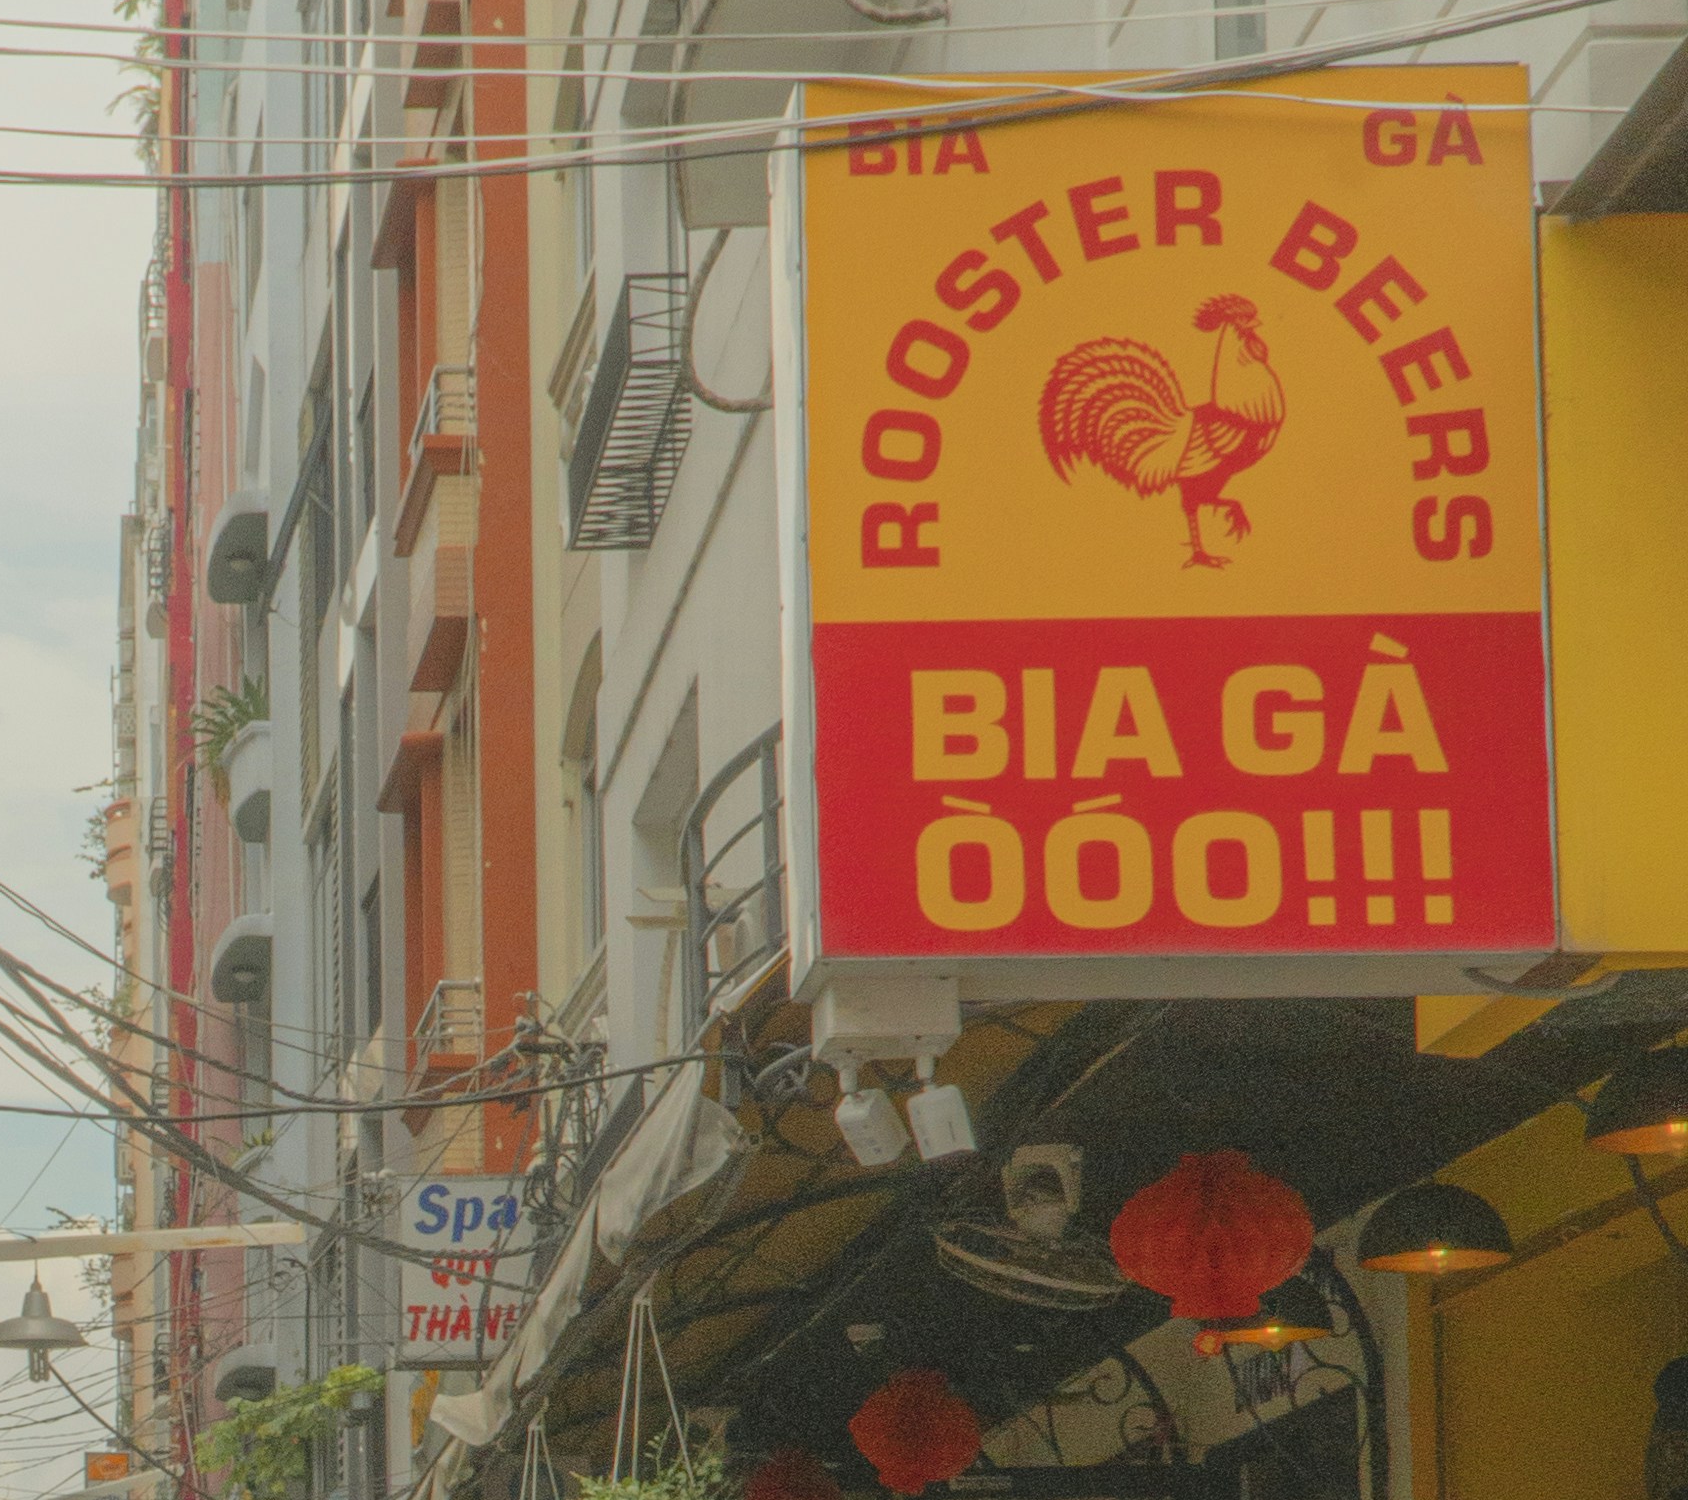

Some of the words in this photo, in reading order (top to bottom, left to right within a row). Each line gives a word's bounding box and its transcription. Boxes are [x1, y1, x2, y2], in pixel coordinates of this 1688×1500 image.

[847, 118, 990, 177] BIA
[1362, 93, 1484, 167] GÀ
[860, 169, 1224, 569] ROOSTER
[1269, 199, 1494, 563] BEERS
[911, 666, 1183, 783] BIA
[1221, 632, 1449, 776] GÀ
[916, 793, 1453, 930] ÒÓO!!!
[414, 1184, 518, 1243] Spa
